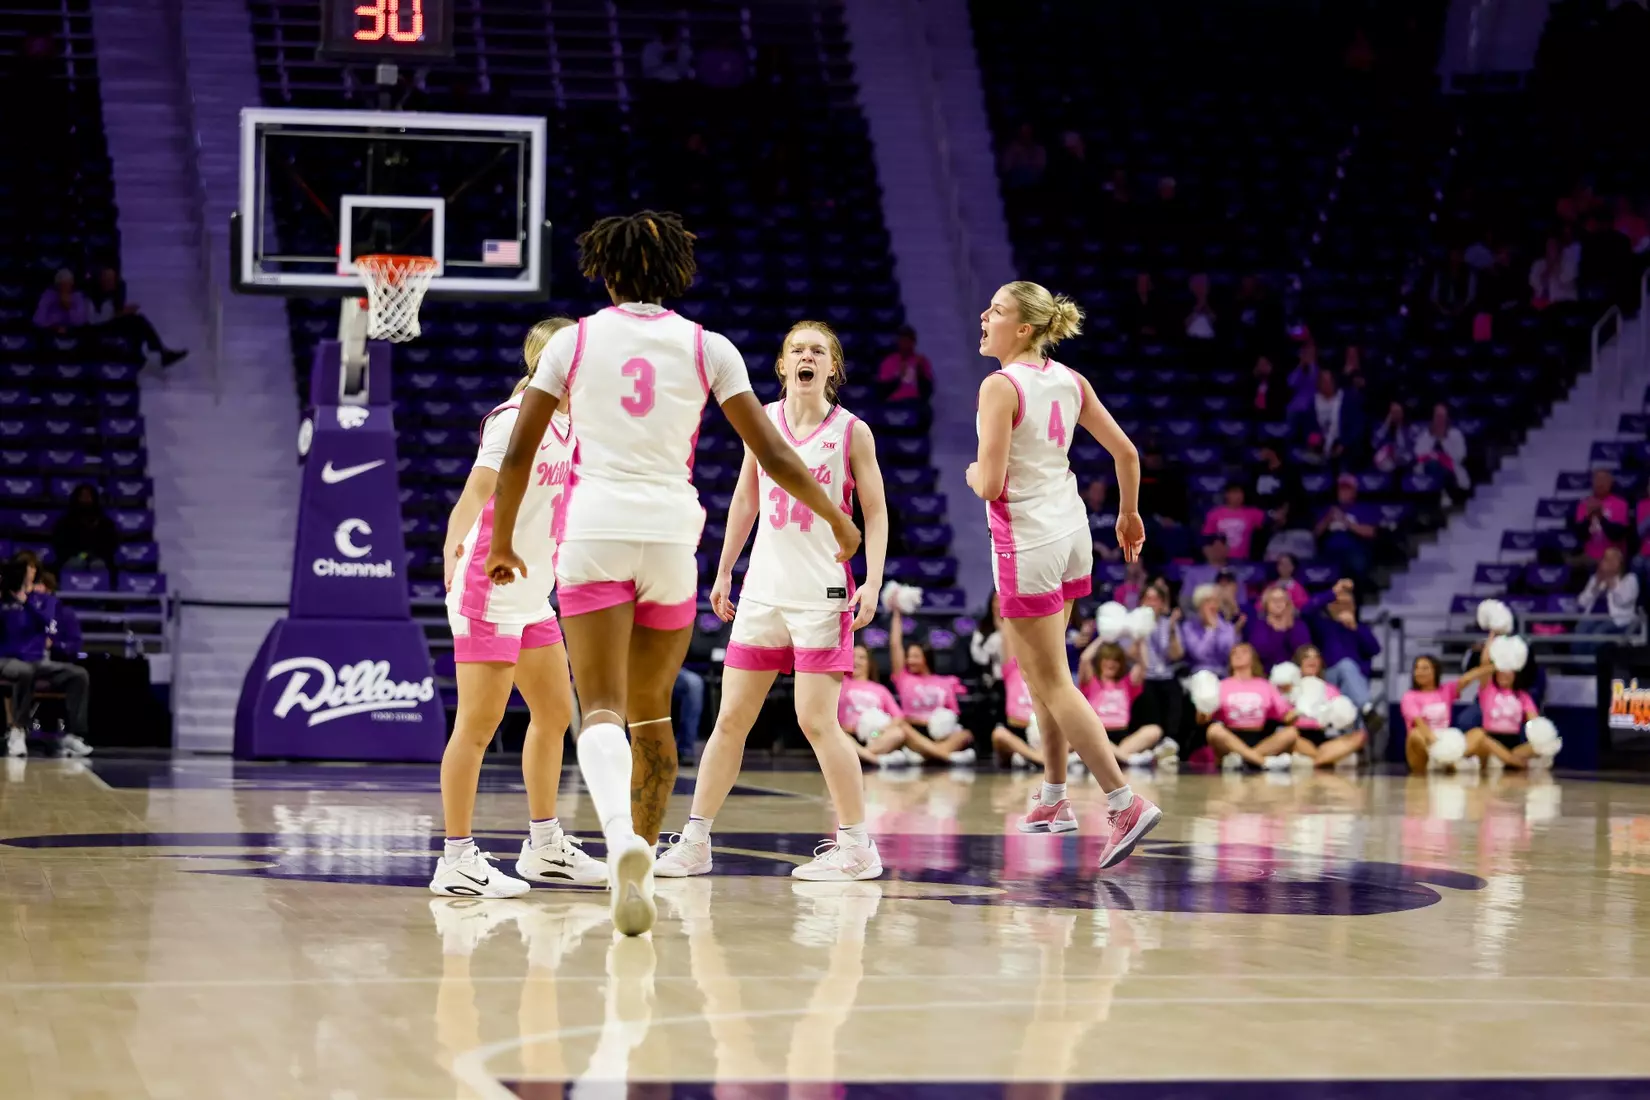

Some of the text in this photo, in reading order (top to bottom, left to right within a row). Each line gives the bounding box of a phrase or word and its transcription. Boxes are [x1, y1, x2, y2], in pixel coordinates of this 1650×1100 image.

[354, 0, 422, 41] 30
[620, 358, 656, 417] 3
[1048, 401, 1065, 448] 4
[769, 486, 814, 532] 34
[266, 656, 434, 719] Dillons
